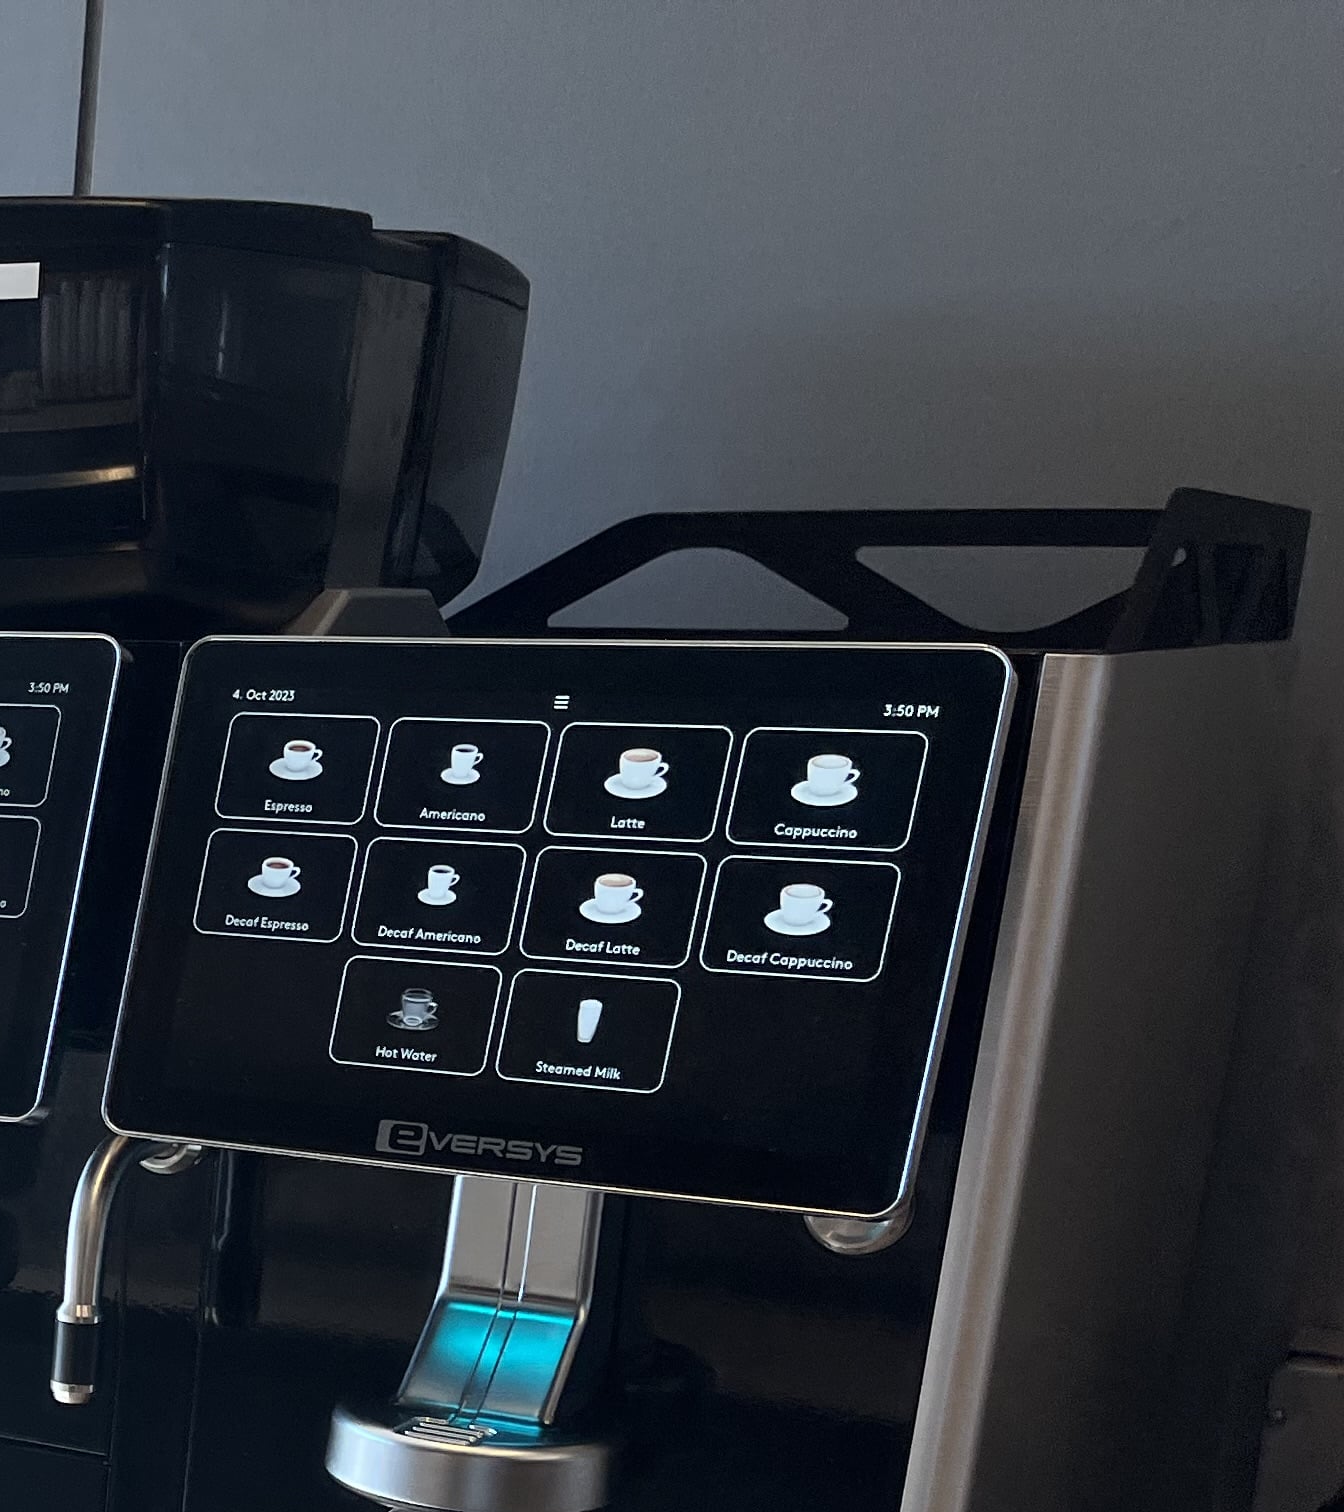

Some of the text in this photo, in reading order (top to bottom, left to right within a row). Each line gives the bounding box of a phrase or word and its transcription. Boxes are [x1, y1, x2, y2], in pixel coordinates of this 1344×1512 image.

[27, 681, 70, 694] 3:50 PM
[246, 688, 268, 701] Oct
[268, 689, 295, 702] 2023
[882, 703, 940, 718] 3:50 PM
[264, 799, 313, 814] Espresso
[419, 807, 486, 822] Americano
[610, 815, 646, 829] Latte
[773, 823, 858, 840] Cappuccino
[225, 914, 309, 932] Decaf Espresso
[377, 925, 482, 944] Decaf Americano
[565, 938, 641, 956] Decaf Latte
[726, 949, 853, 970] Decaf Cappuccino
[375, 1045, 438, 1062] Hot Water
[535, 1060, 621, 1080] Steamed Milk
